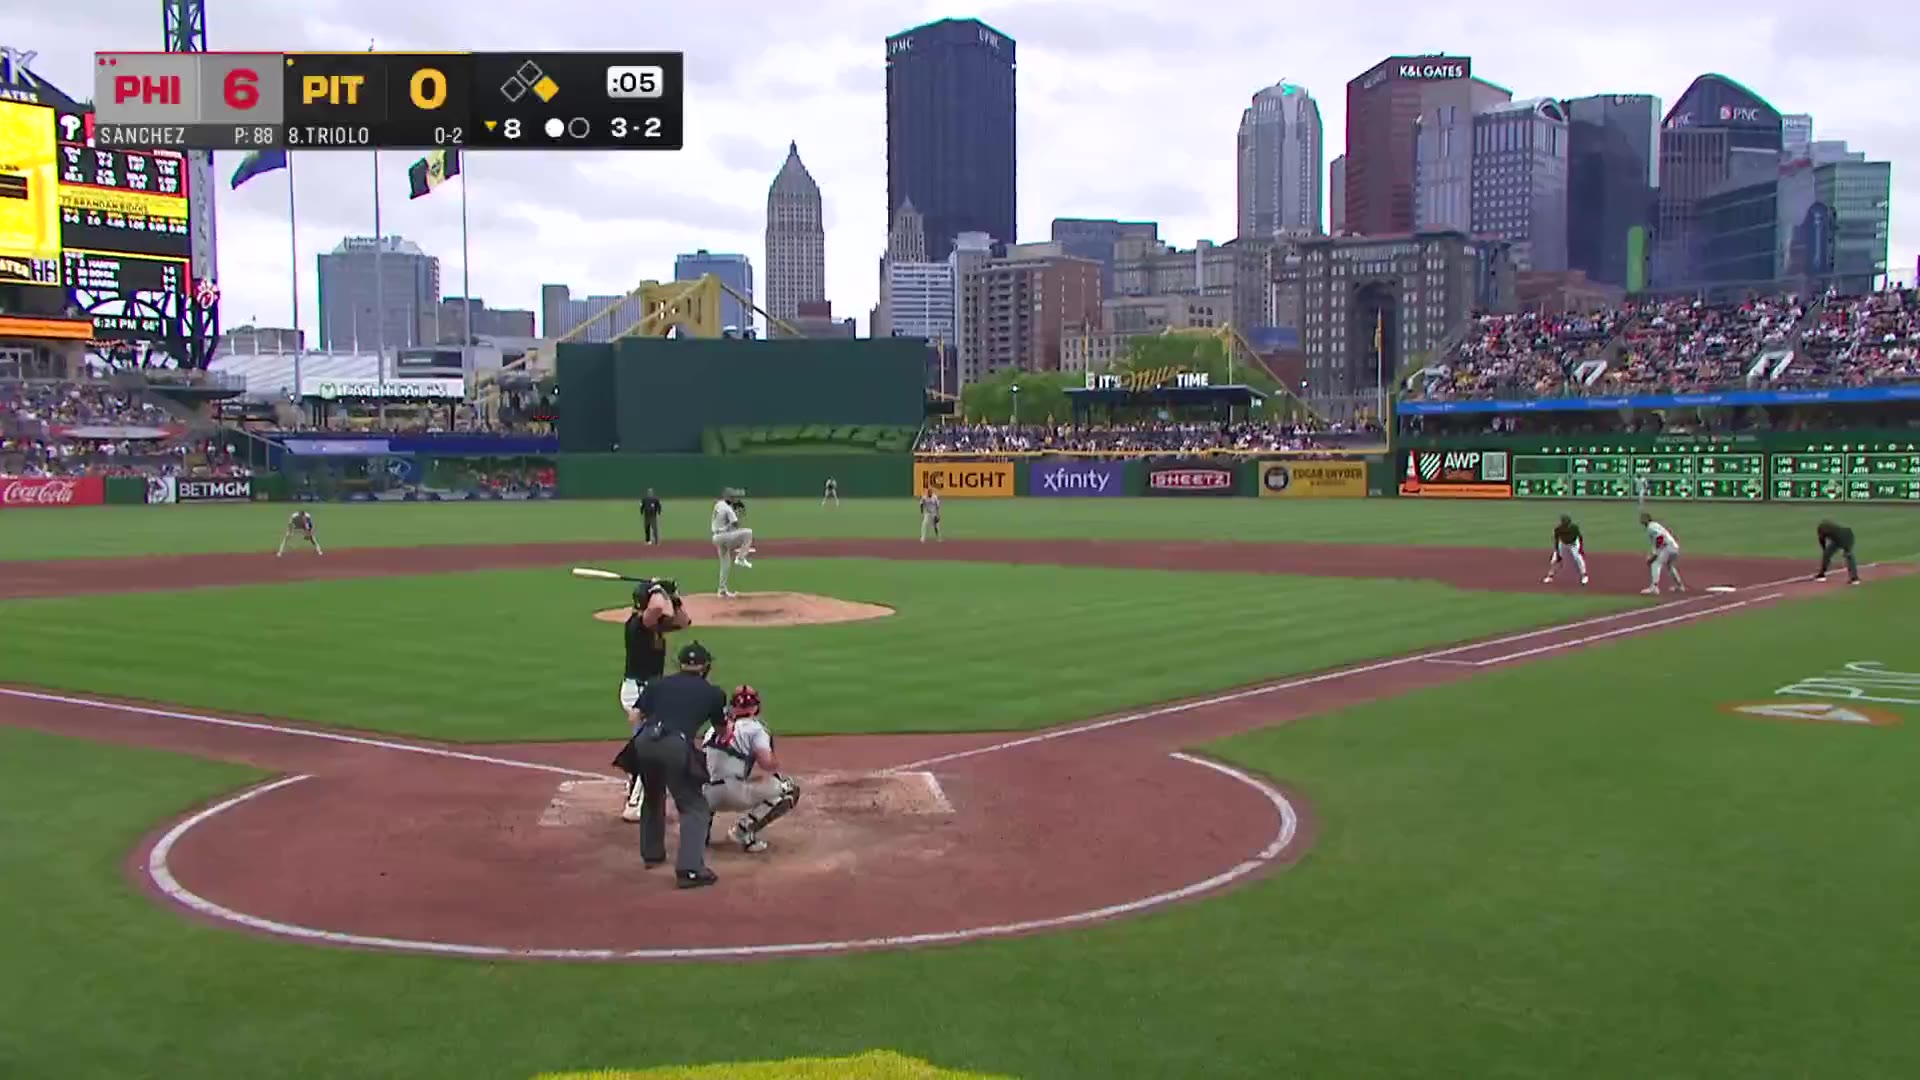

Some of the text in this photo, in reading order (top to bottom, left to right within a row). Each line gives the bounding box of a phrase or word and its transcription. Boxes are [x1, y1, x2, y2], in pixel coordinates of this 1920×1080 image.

[1400, 65, 1462, 78] K&L GATES
[1733, 108, 1759, 121] PNC
[1099, 373, 1208, 388] IT'S TIME
[1444, 452, 1480, 469] AWP
[949, 472, 1006, 488] LIGHT
[1044, 469, 1110, 492] xfinity
[1155, 472, 1226, 487] SHEETZ
[3, 480, 75, 504] Coca-Cola
[179, 482, 250, 497] BETMGM
